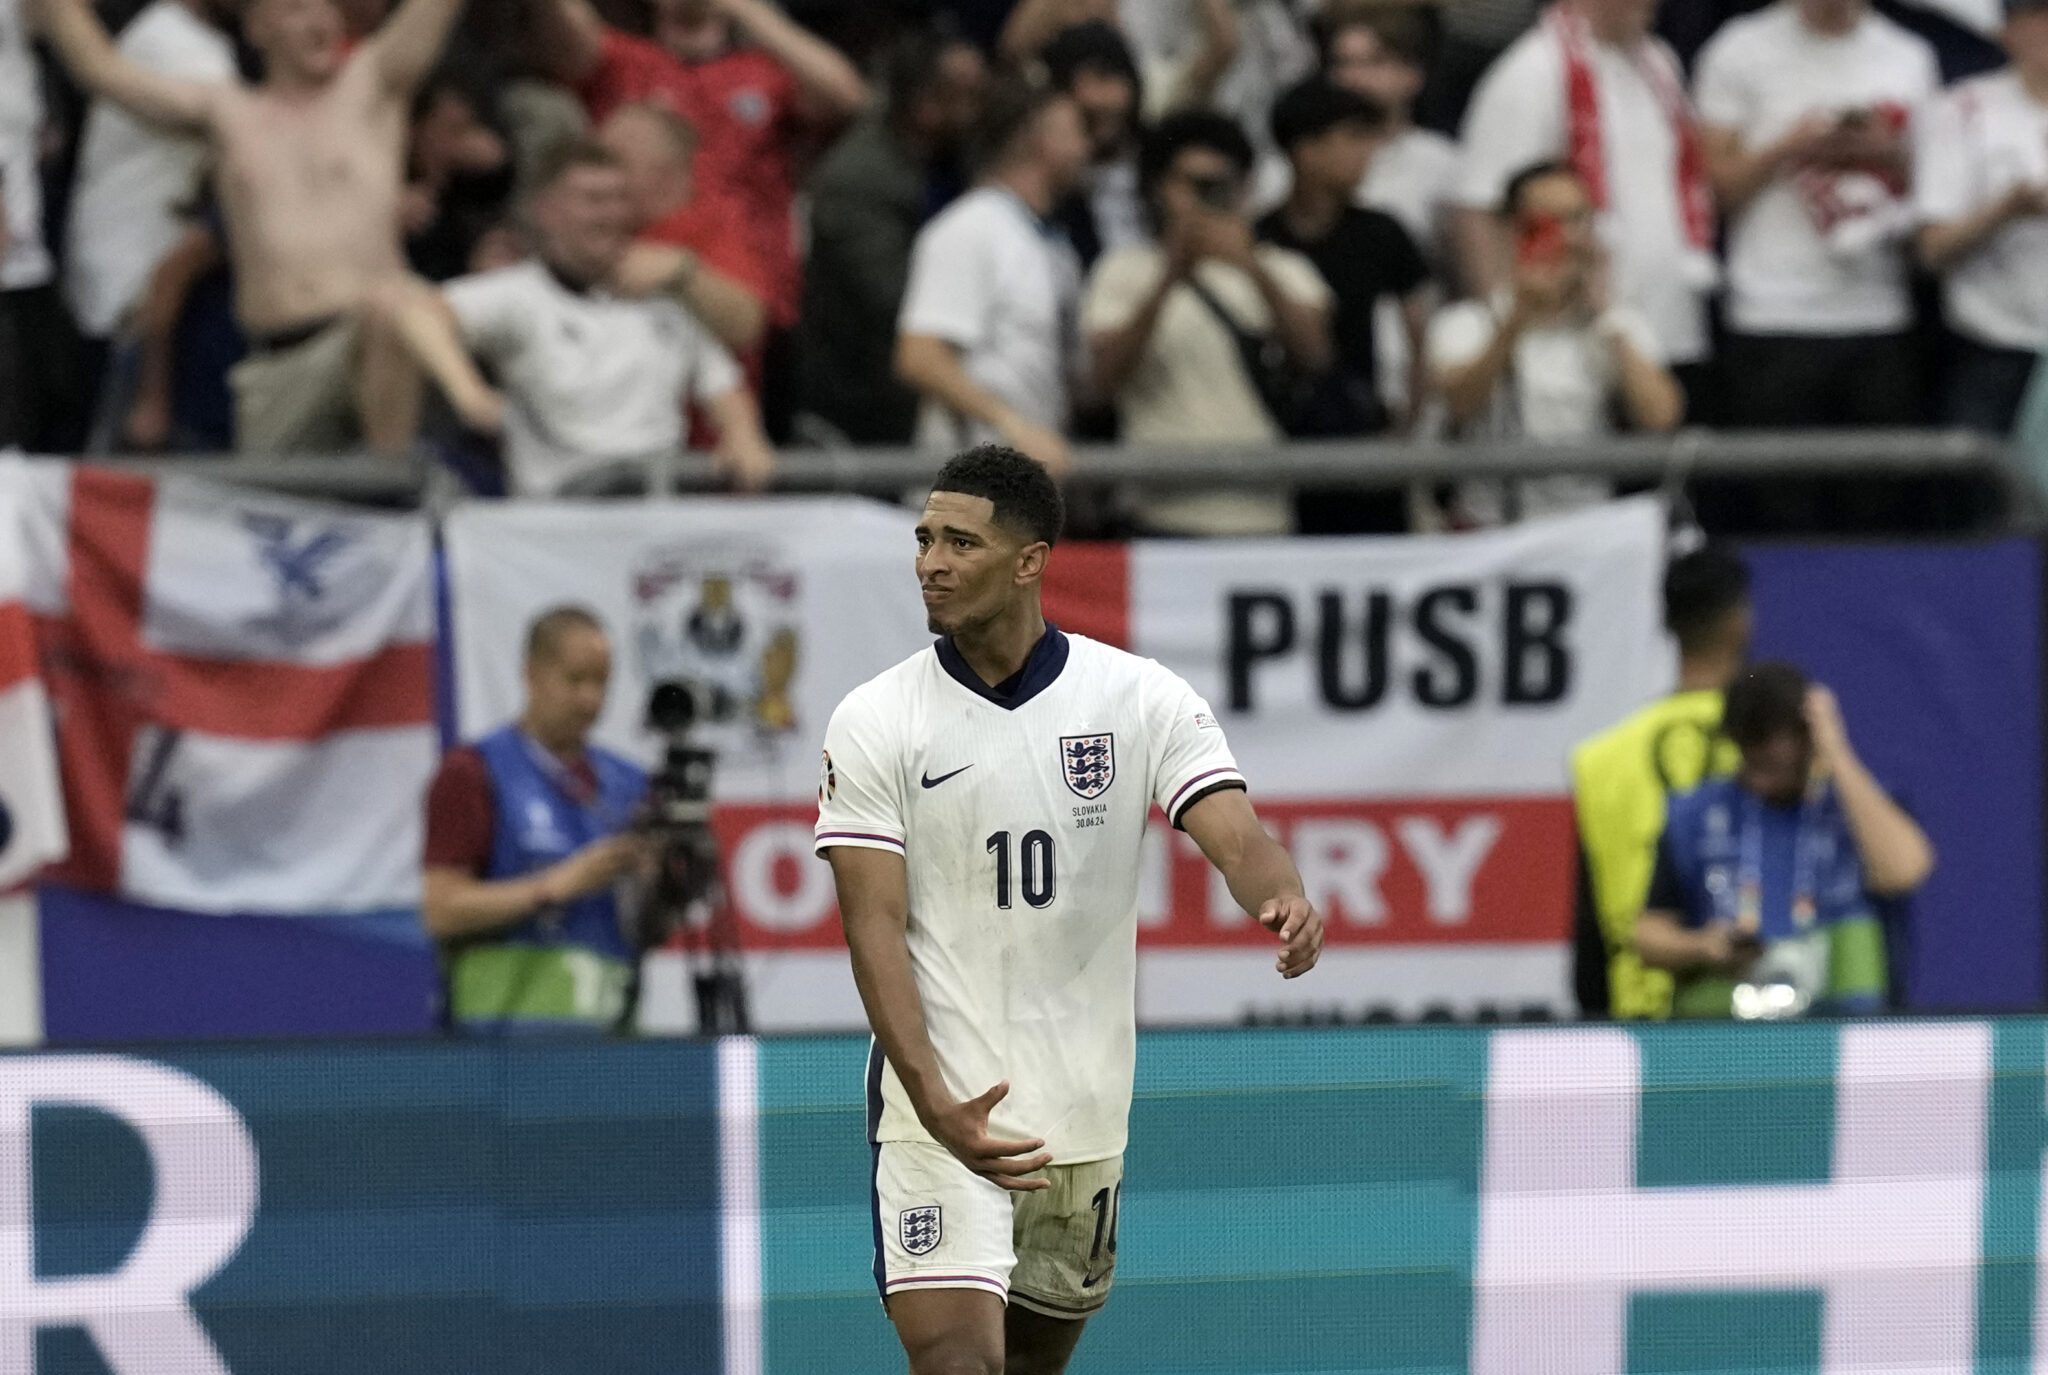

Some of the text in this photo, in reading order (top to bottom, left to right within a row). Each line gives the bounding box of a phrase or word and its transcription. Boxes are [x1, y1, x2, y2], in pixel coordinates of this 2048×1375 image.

[1226, 580, 1574, 713] PUSB
[1072, 803, 1107, 817] SLOVAKIA
[1076, 816, 1105, 828] 30.06.24
[986, 829, 1056, 909] 10
[1470, 1022, 2048, 1375] H
